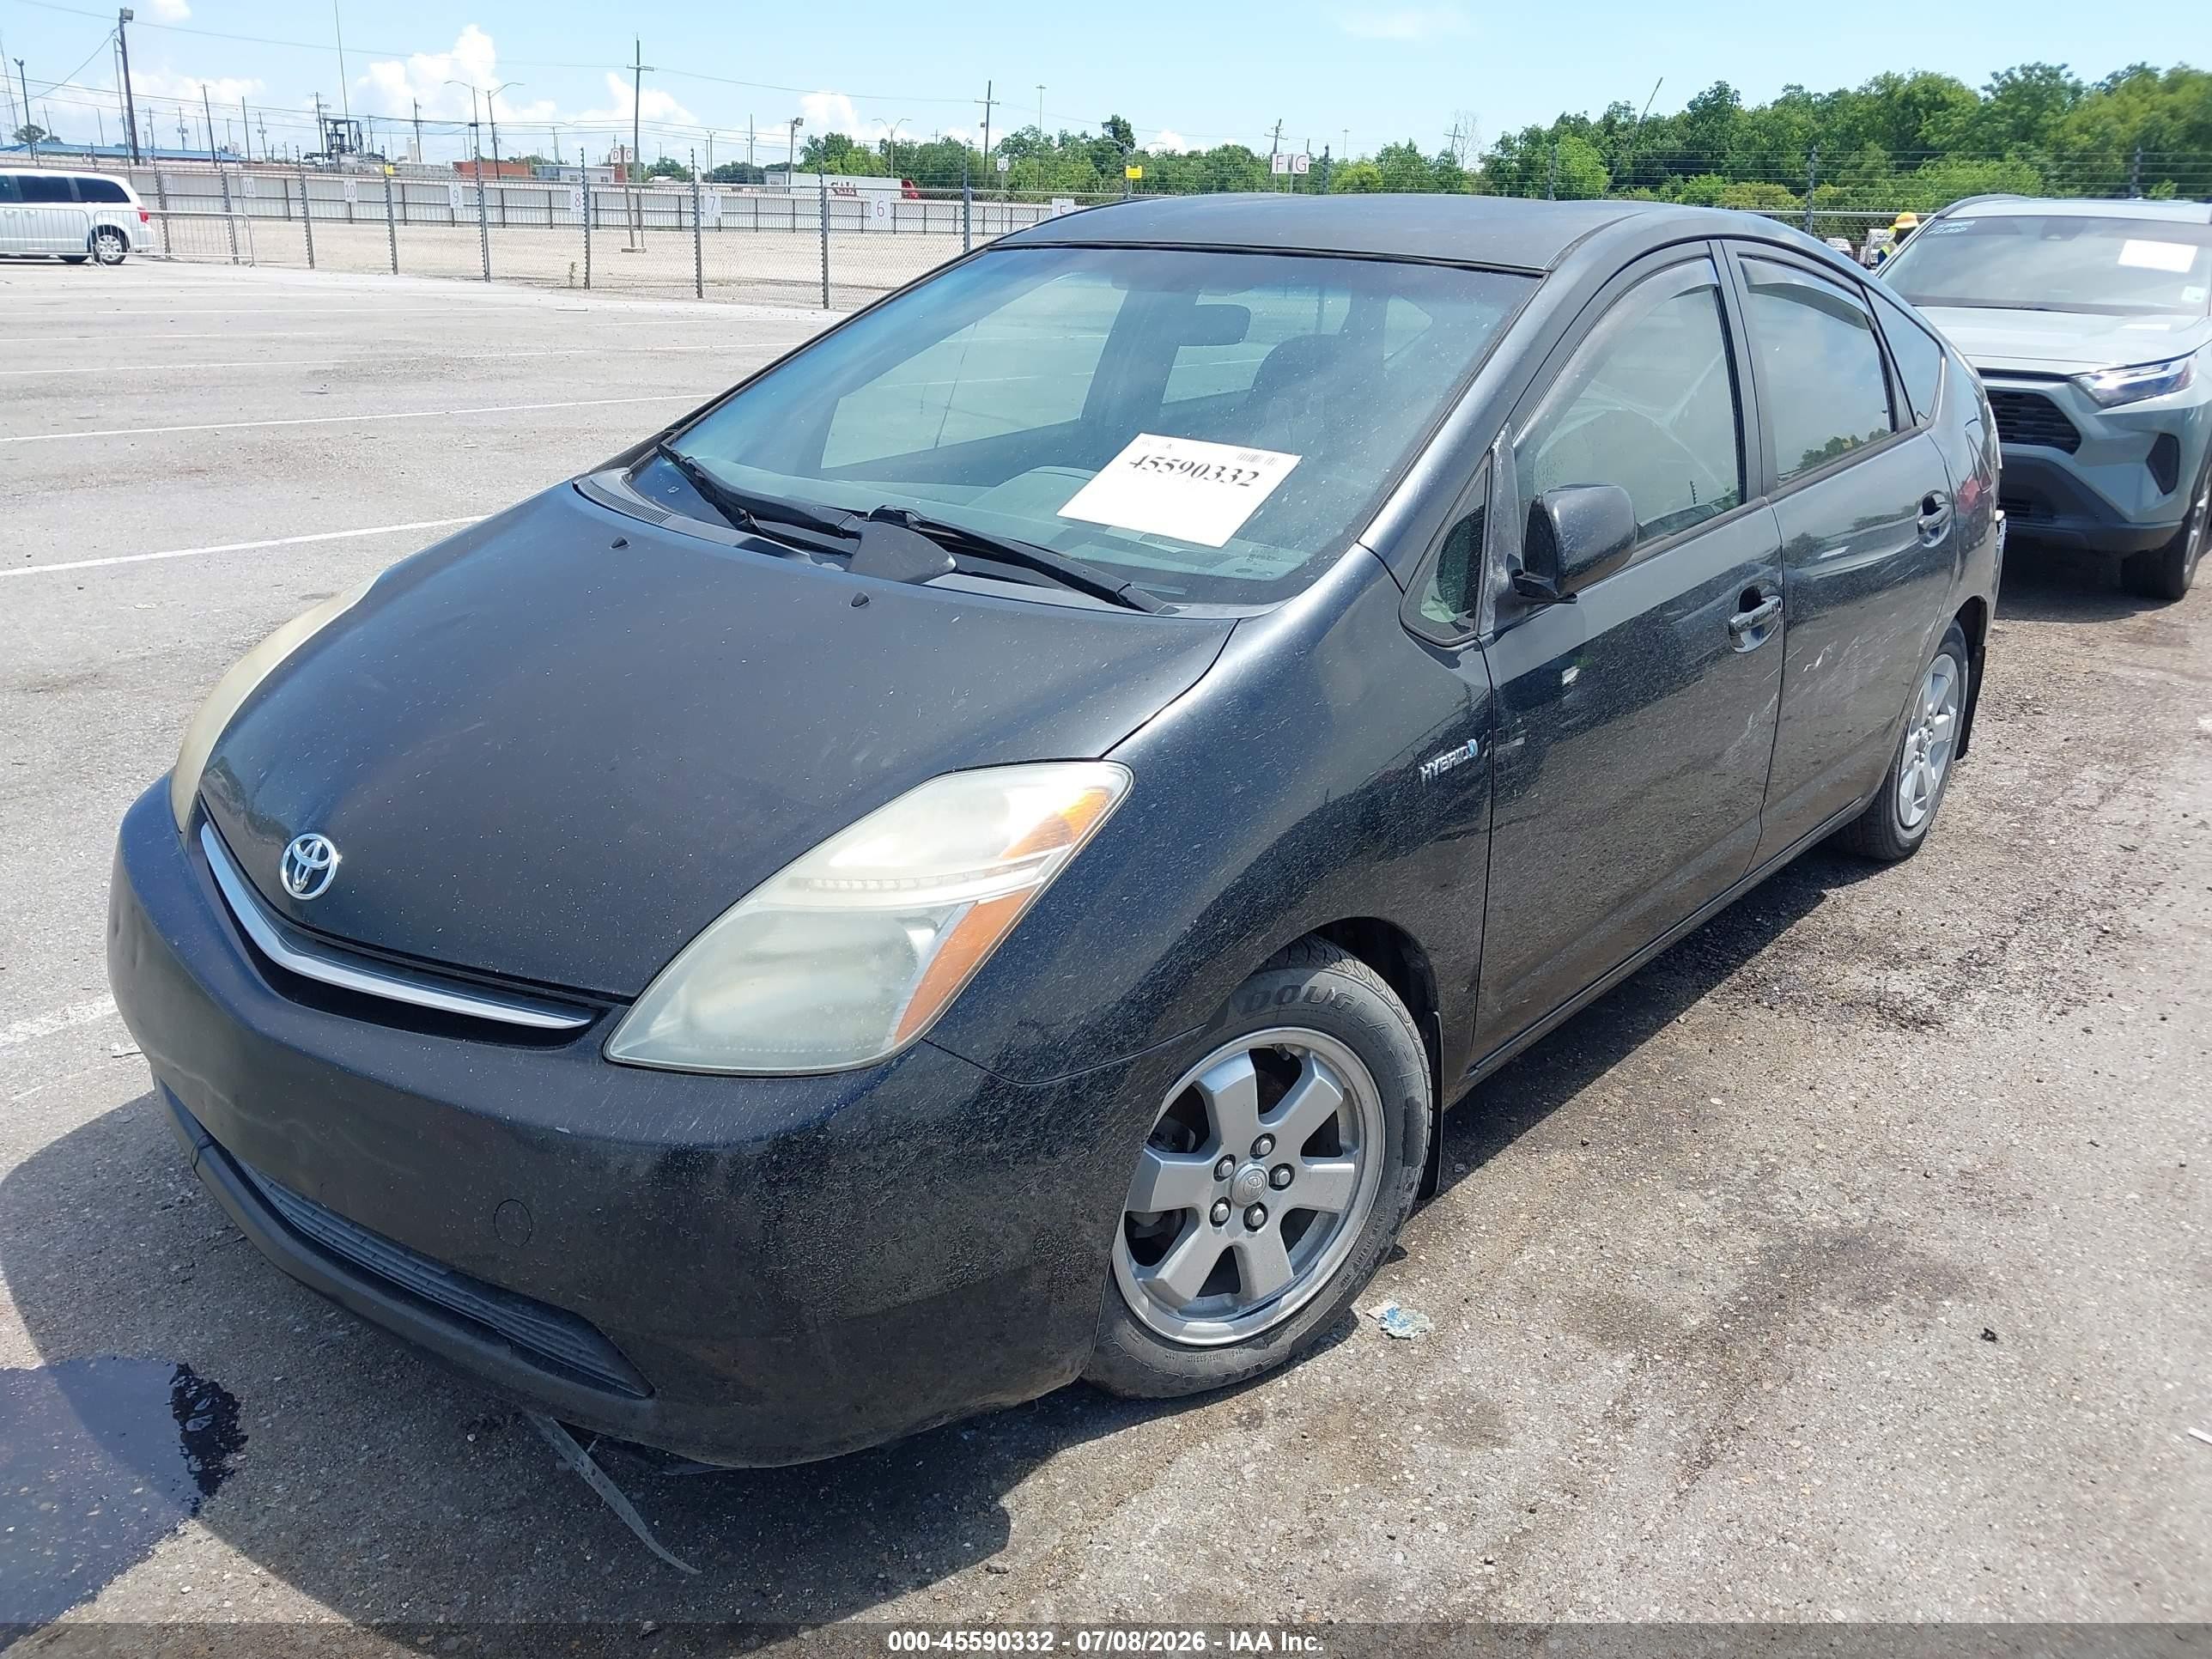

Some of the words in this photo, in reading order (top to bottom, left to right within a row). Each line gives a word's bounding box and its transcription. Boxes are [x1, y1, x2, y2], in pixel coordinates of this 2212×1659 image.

[613, 149, 619, 161] D
[626, 149, 632, 161] C
[1276, 155, 1284, 173] F
[1296, 155, 1307, 173] G
[245, 180, 255, 194] 11
[345, 184, 356, 198] 10
[453, 189, 459, 204] 9
[574, 191, 581, 207] 8
[709, 196, 717, 212] 7
[877, 200, 885, 217] 6
[1129, 454, 1260, 488] 45590332
[1419, 738, 1478, 785] HYBRID
